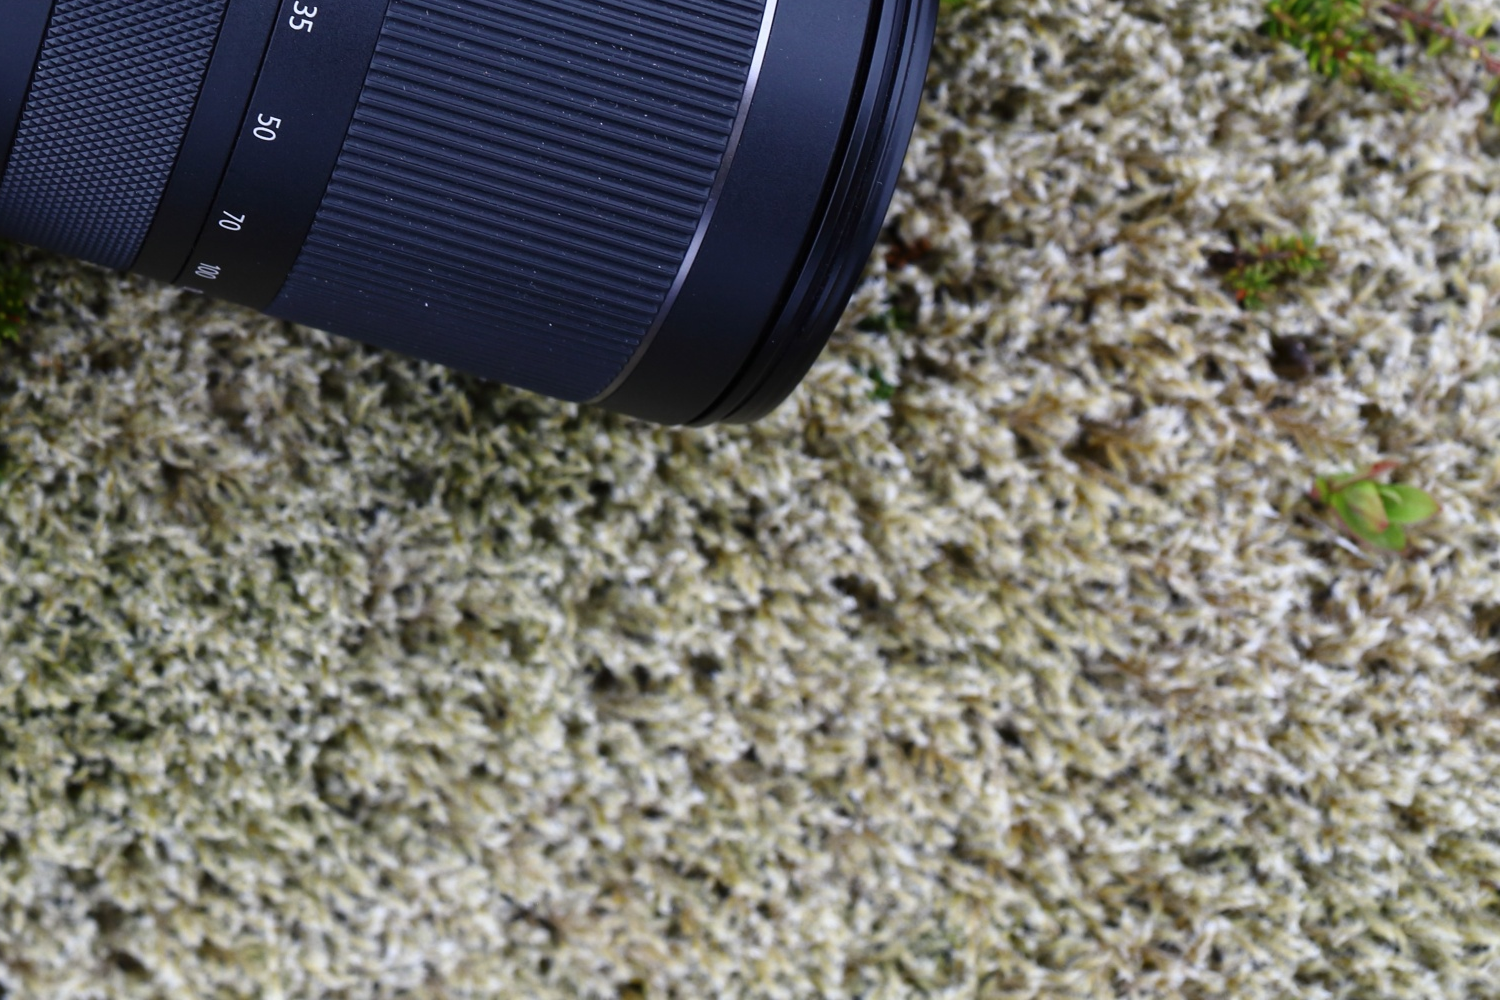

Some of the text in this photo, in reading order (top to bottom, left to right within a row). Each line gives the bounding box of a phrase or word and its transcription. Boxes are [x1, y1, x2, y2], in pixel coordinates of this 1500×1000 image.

[289, 0, 318, 33] 35
[253, 113, 281, 141] 50
[218, 210, 245, 231] 70
[195, 262, 221, 280] 100
